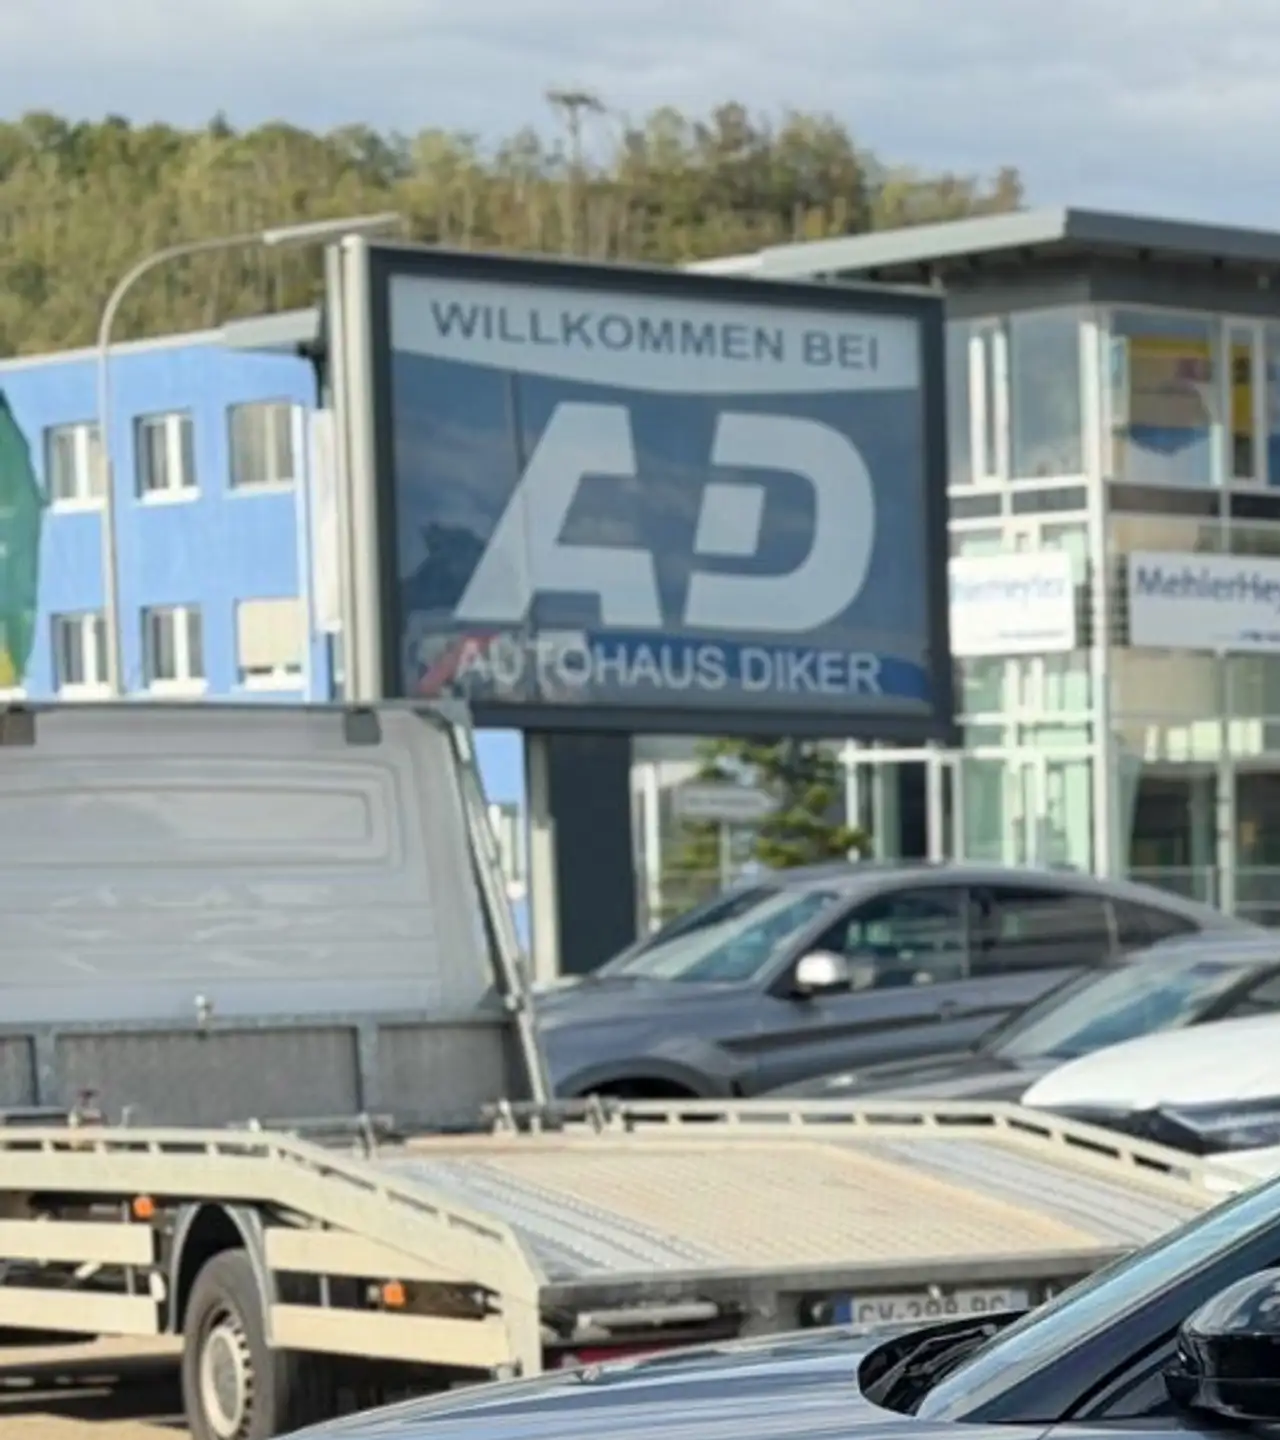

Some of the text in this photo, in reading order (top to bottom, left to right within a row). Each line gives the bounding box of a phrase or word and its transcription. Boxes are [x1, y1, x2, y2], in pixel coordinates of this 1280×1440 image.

[430, 301, 879, 371] WILLKOMMEN BEI
[453, 401, 876, 633] AD
[455, 636, 882, 694] AUTOHAUS DIKER
